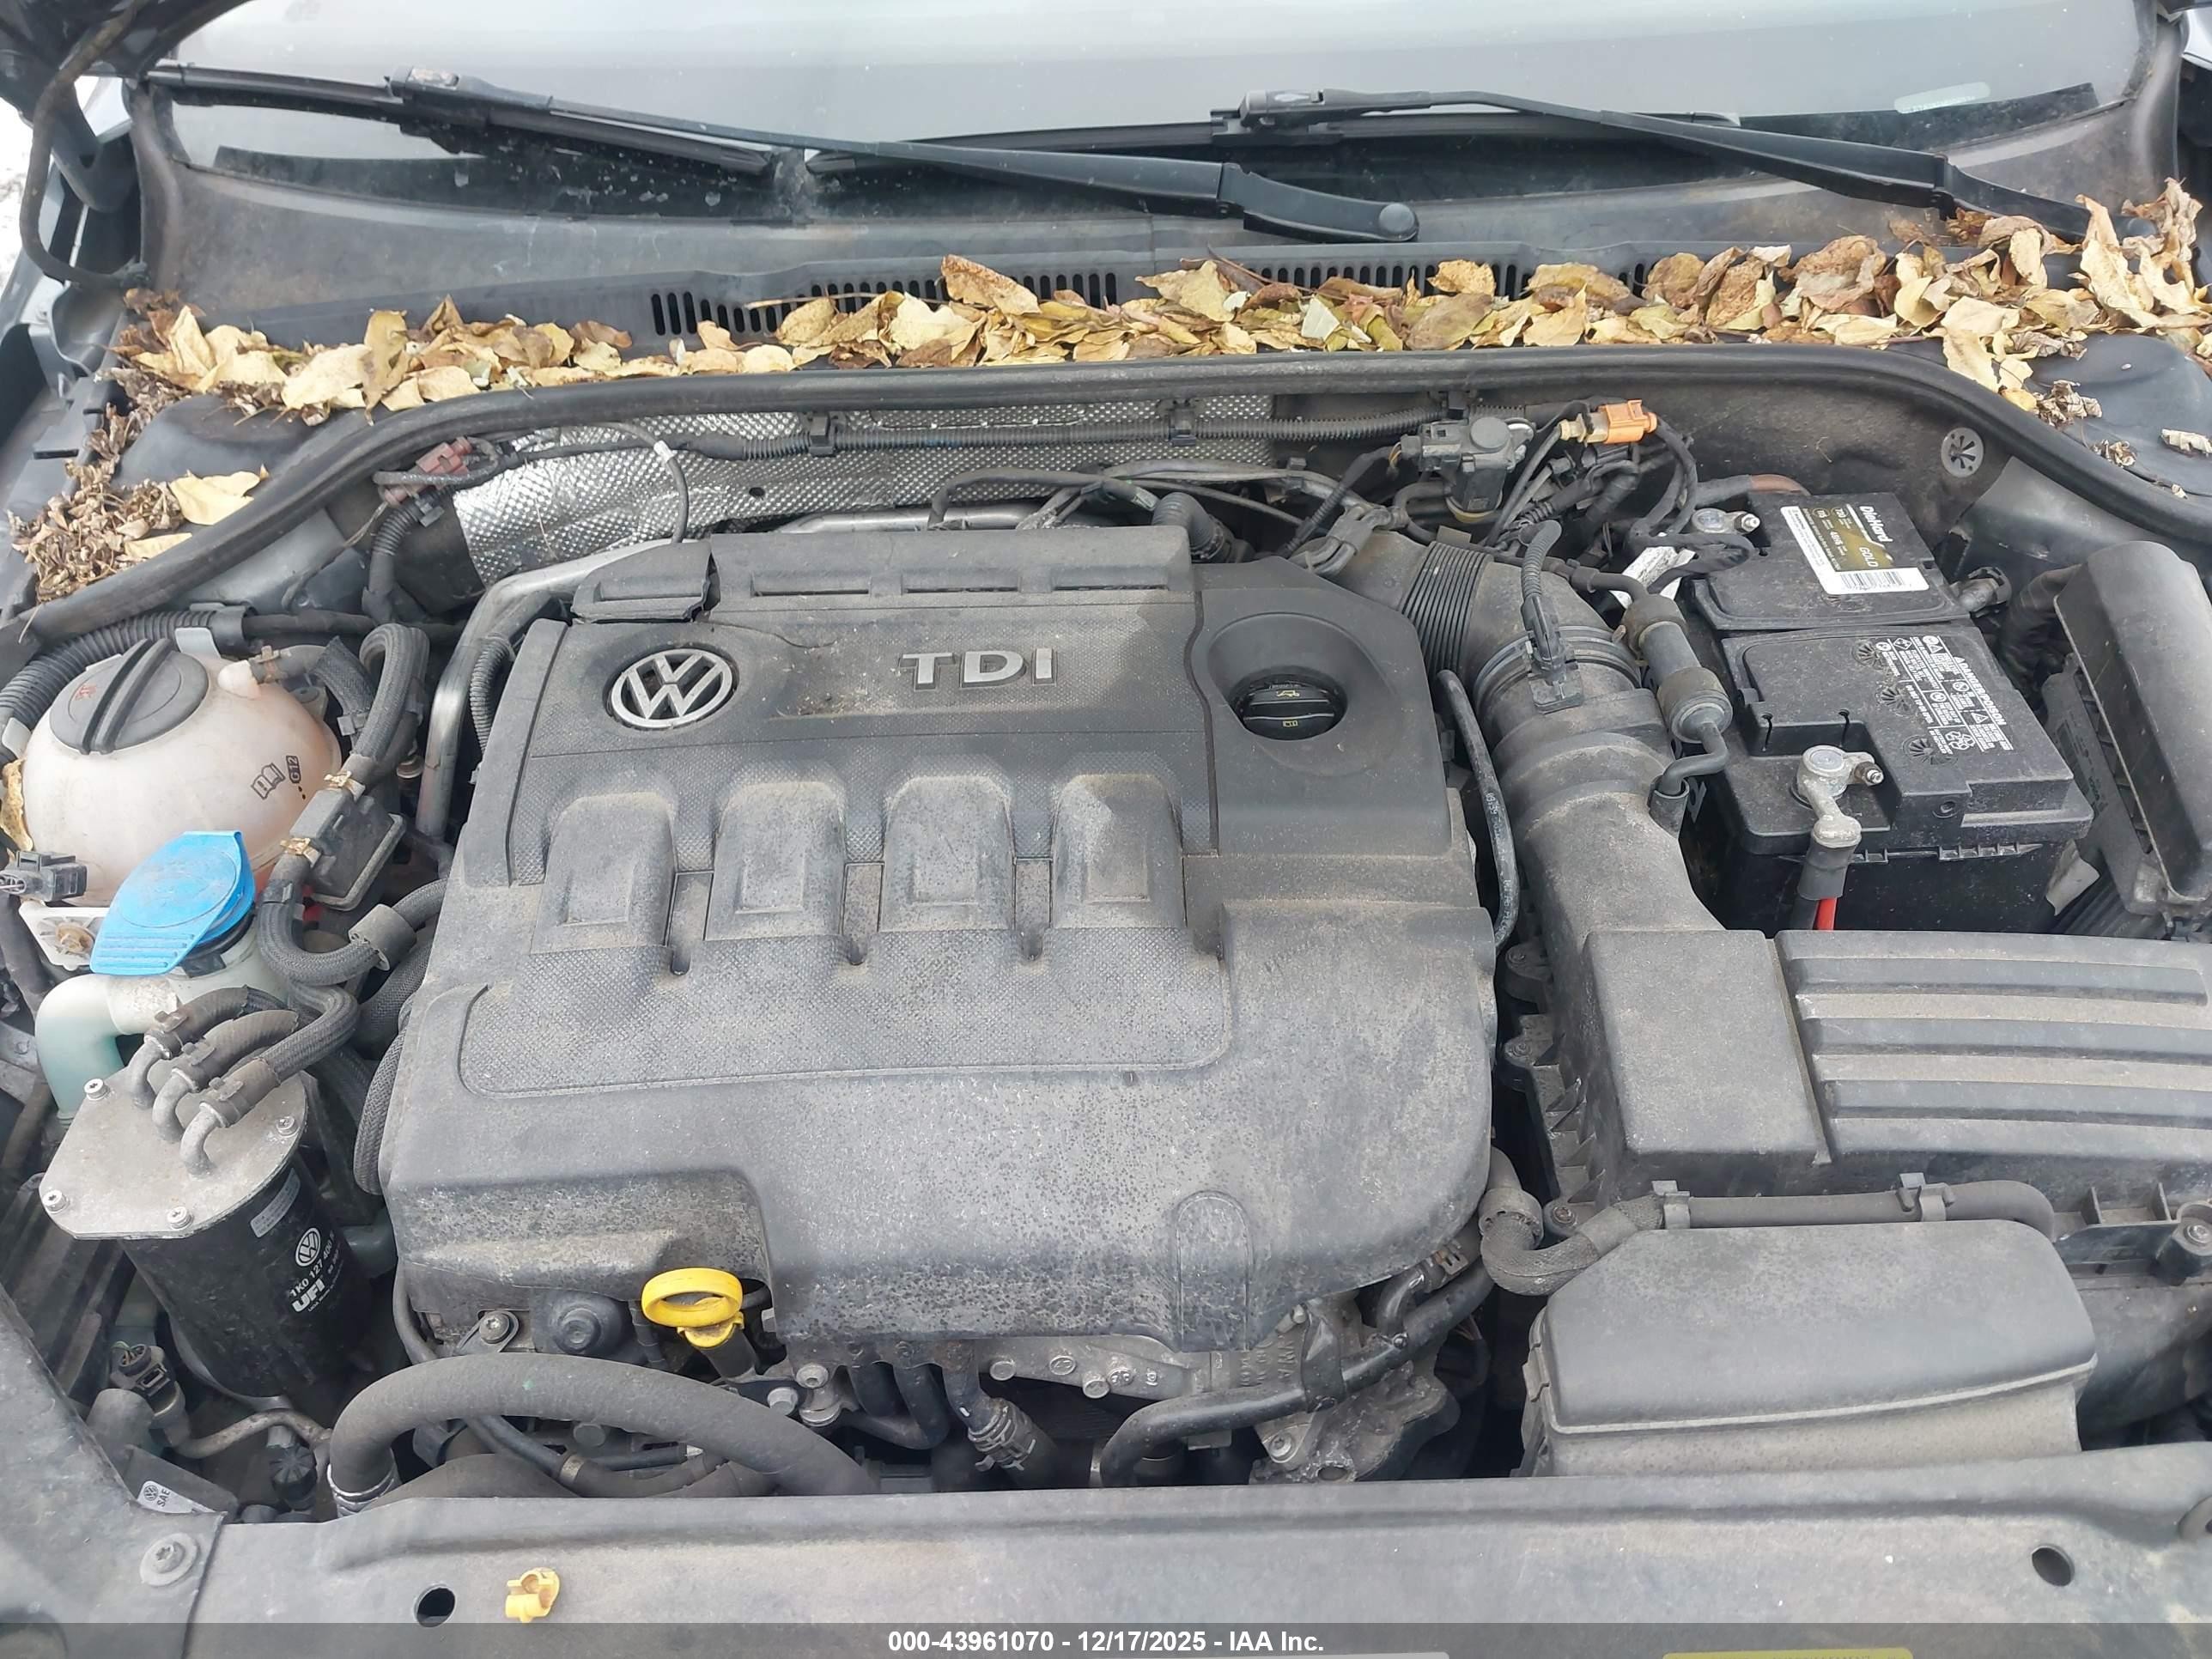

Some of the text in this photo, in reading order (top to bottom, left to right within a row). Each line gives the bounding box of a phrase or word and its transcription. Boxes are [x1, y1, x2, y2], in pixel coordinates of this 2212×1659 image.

[1859, 506, 1893, 543] DieHard
[1859, 547, 1879, 568] GOLD
[900, 647, 1055, 688] TDI
[611, 648, 732, 728] VW
[288, 756, 301, 781] G12
[289, 1278, 309, 1297] 1K0
[309, 1259, 323, 1278] 127
[292, 1279, 325, 1312] UFI
[157, 1488, 171, 1507] SAE
